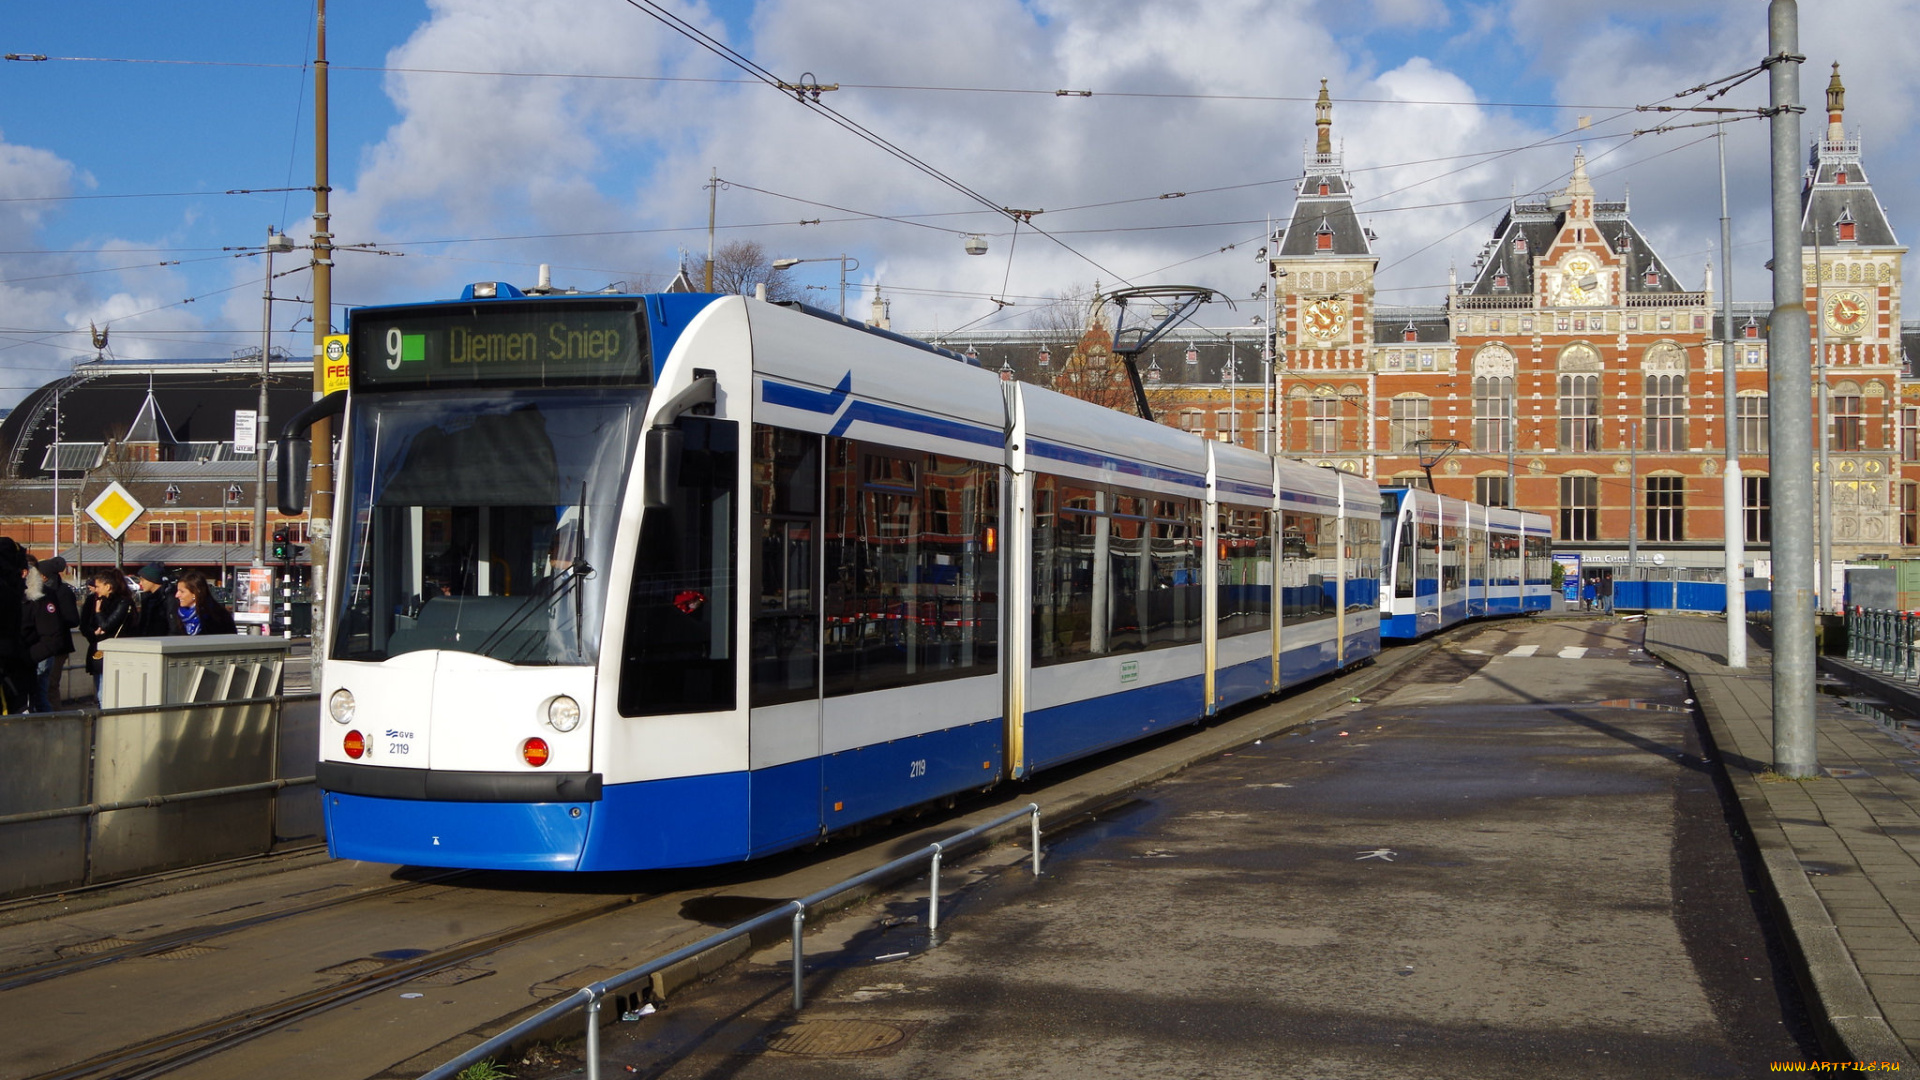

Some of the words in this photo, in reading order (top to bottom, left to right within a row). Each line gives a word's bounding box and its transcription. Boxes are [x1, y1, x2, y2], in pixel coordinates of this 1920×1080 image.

[386, 327, 402, 371] 9
[450, 326, 537, 363] Diemen
[549, 322, 620, 362] Sniep
[1581, 554, 1601, 563] dam
[1604, 554, 1648, 563] Cental
[399, 731, 414, 739] GVB
[389, 742, 409, 755] 2119
[910, 759, 926, 778] 2119
